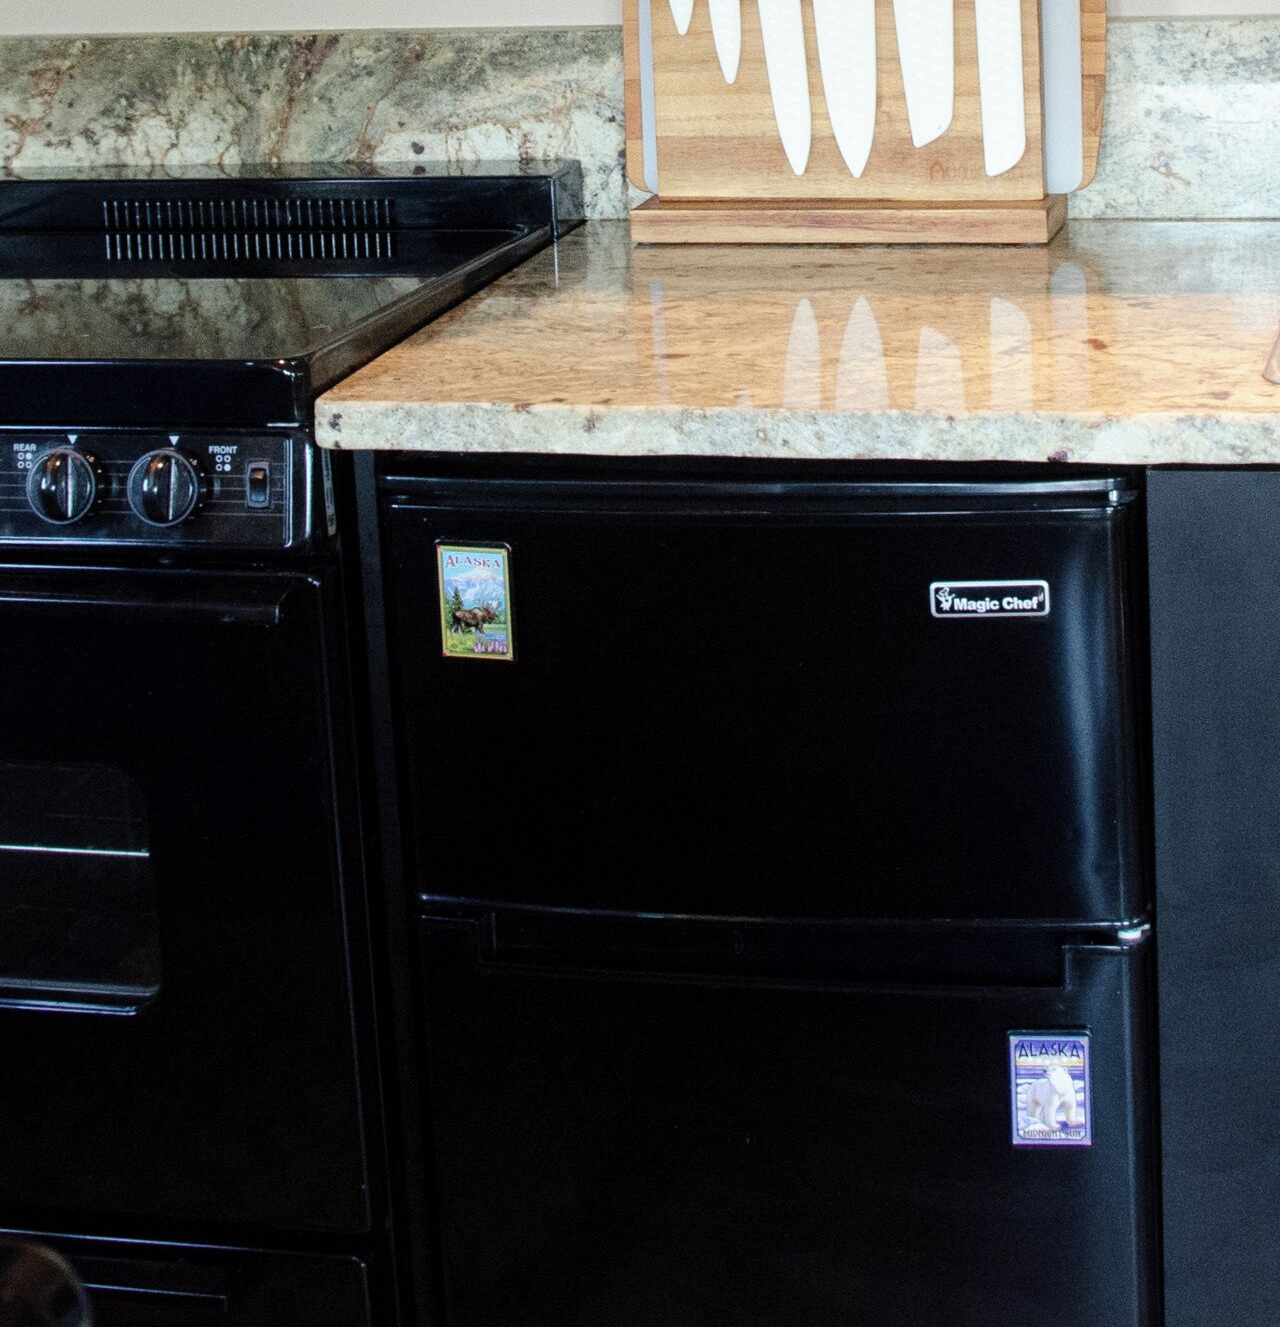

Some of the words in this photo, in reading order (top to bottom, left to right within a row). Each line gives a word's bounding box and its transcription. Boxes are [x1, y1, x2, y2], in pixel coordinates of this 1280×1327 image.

[13, 443, 36, 452] REAR
[208, 445, 238, 454] FRONT
[446, 555, 501, 568] ALASKA
[953, 597, 999, 612] Magic
[1002, 596, 1039, 610] Chef
[1018, 1042, 1081, 1059] ALASKA
